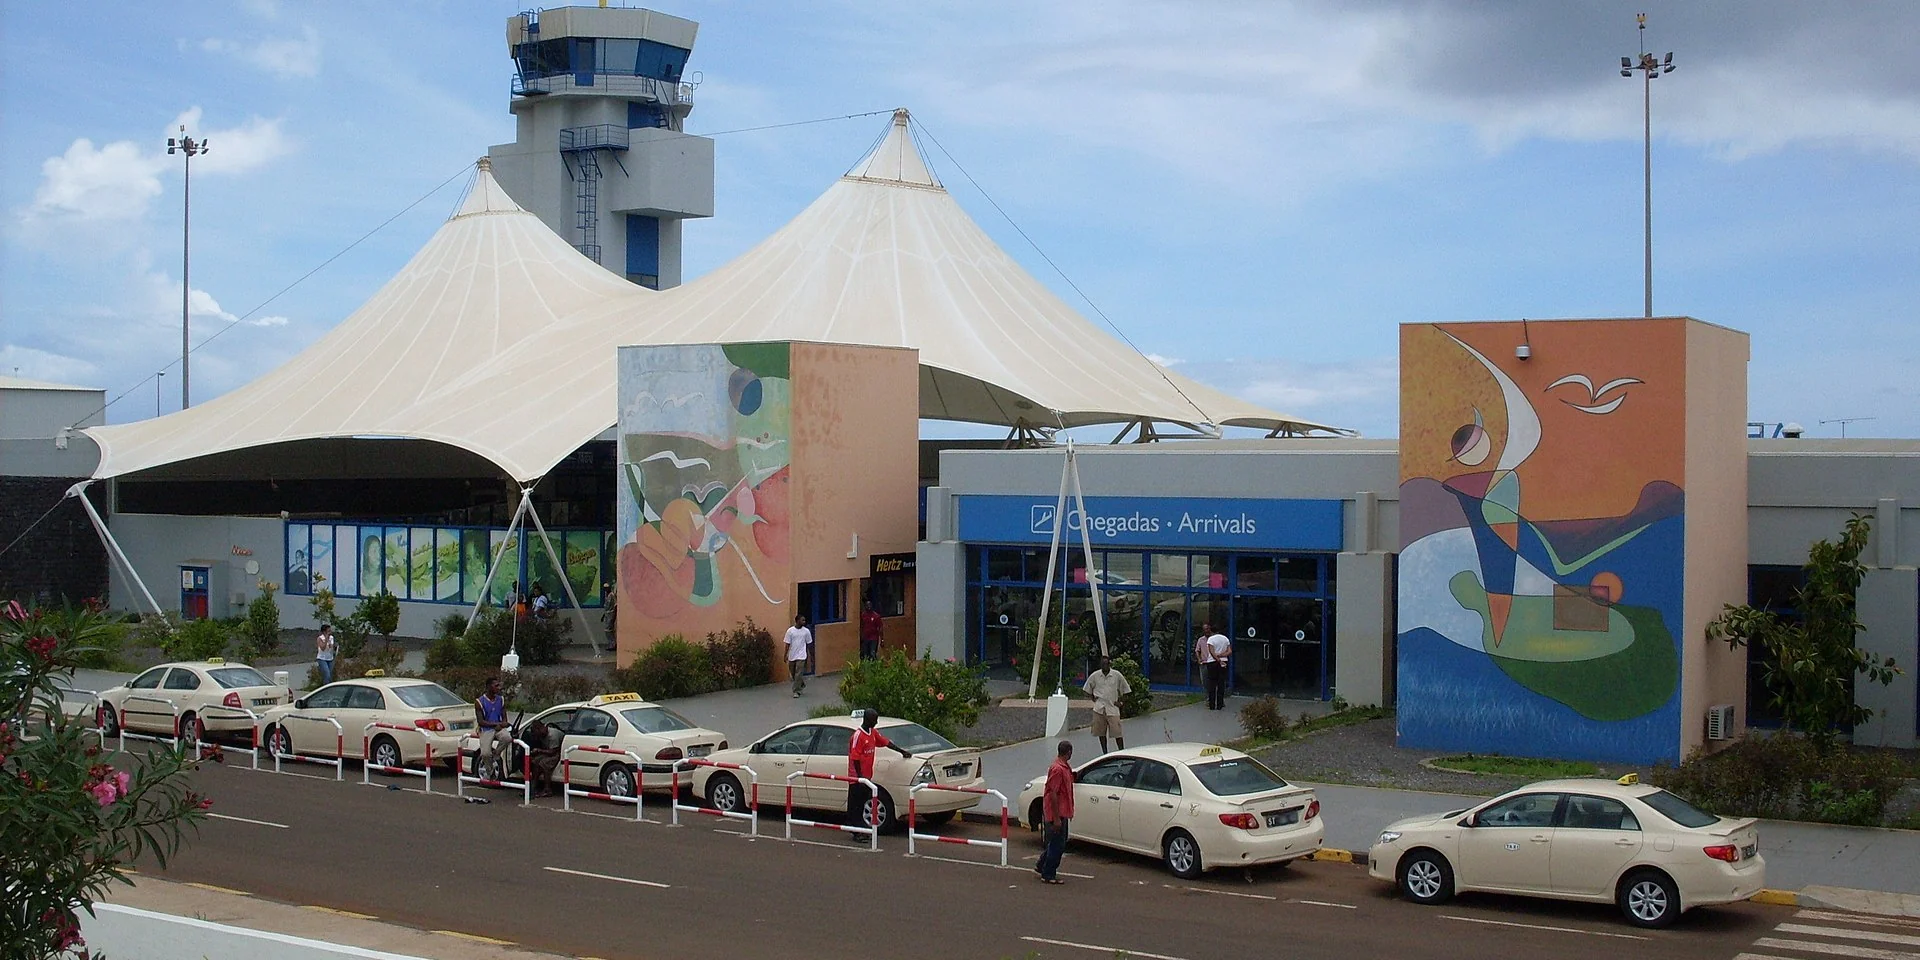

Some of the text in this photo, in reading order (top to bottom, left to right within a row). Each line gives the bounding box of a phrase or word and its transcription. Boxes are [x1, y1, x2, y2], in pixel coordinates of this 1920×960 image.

[1067, 510, 1256, 537] Chegadas Arrivals
[876, 558, 902, 572] Hertz
